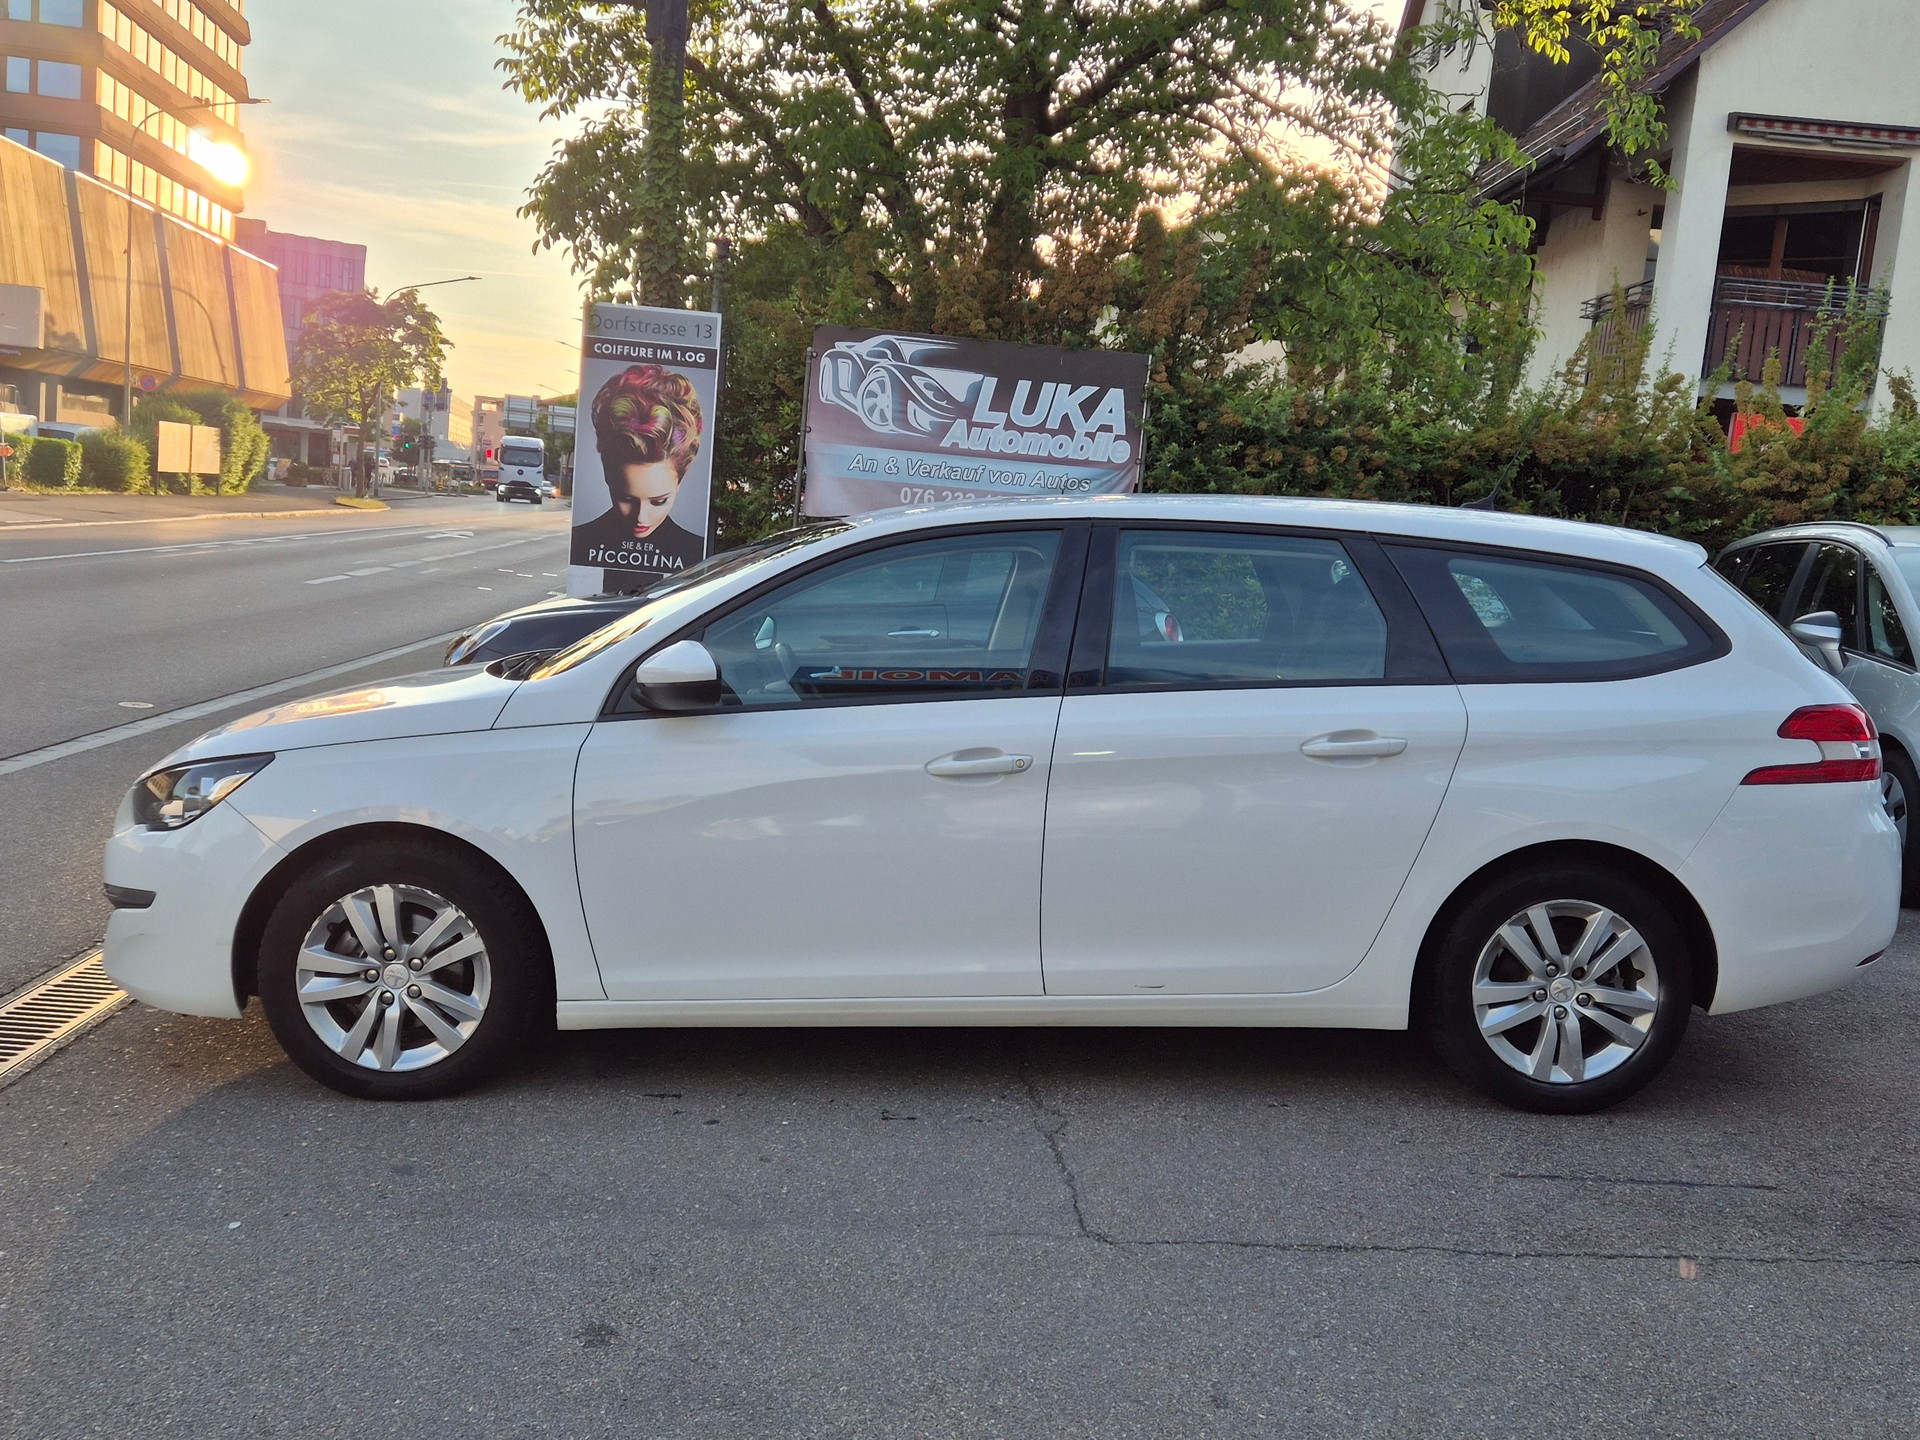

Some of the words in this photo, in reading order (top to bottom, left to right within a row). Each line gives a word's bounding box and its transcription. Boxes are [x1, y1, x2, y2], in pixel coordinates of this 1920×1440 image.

[590, 313, 687, 337] Dorfstrasse
[694, 323, 713, 339] 13
[593, 342, 654, 358] COIFFURE
[656, 349, 672, 360] IM
[676, 350, 706, 363] 1.OG
[971, 376, 1126, 436] LUKA
[939, 418, 1131, 464] Automobile
[848, 453, 878, 473] An
[884, 457, 900, 475] &
[906, 459, 985, 483] Verkauf
[989, 469, 1026, 487] von
[1029, 472, 1092, 494] Autos
[900, 487, 935, 506] 076
[621, 541, 634, 550] SIE
[635, 542, 642, 550] &
[643, 543, 654, 551] ER
